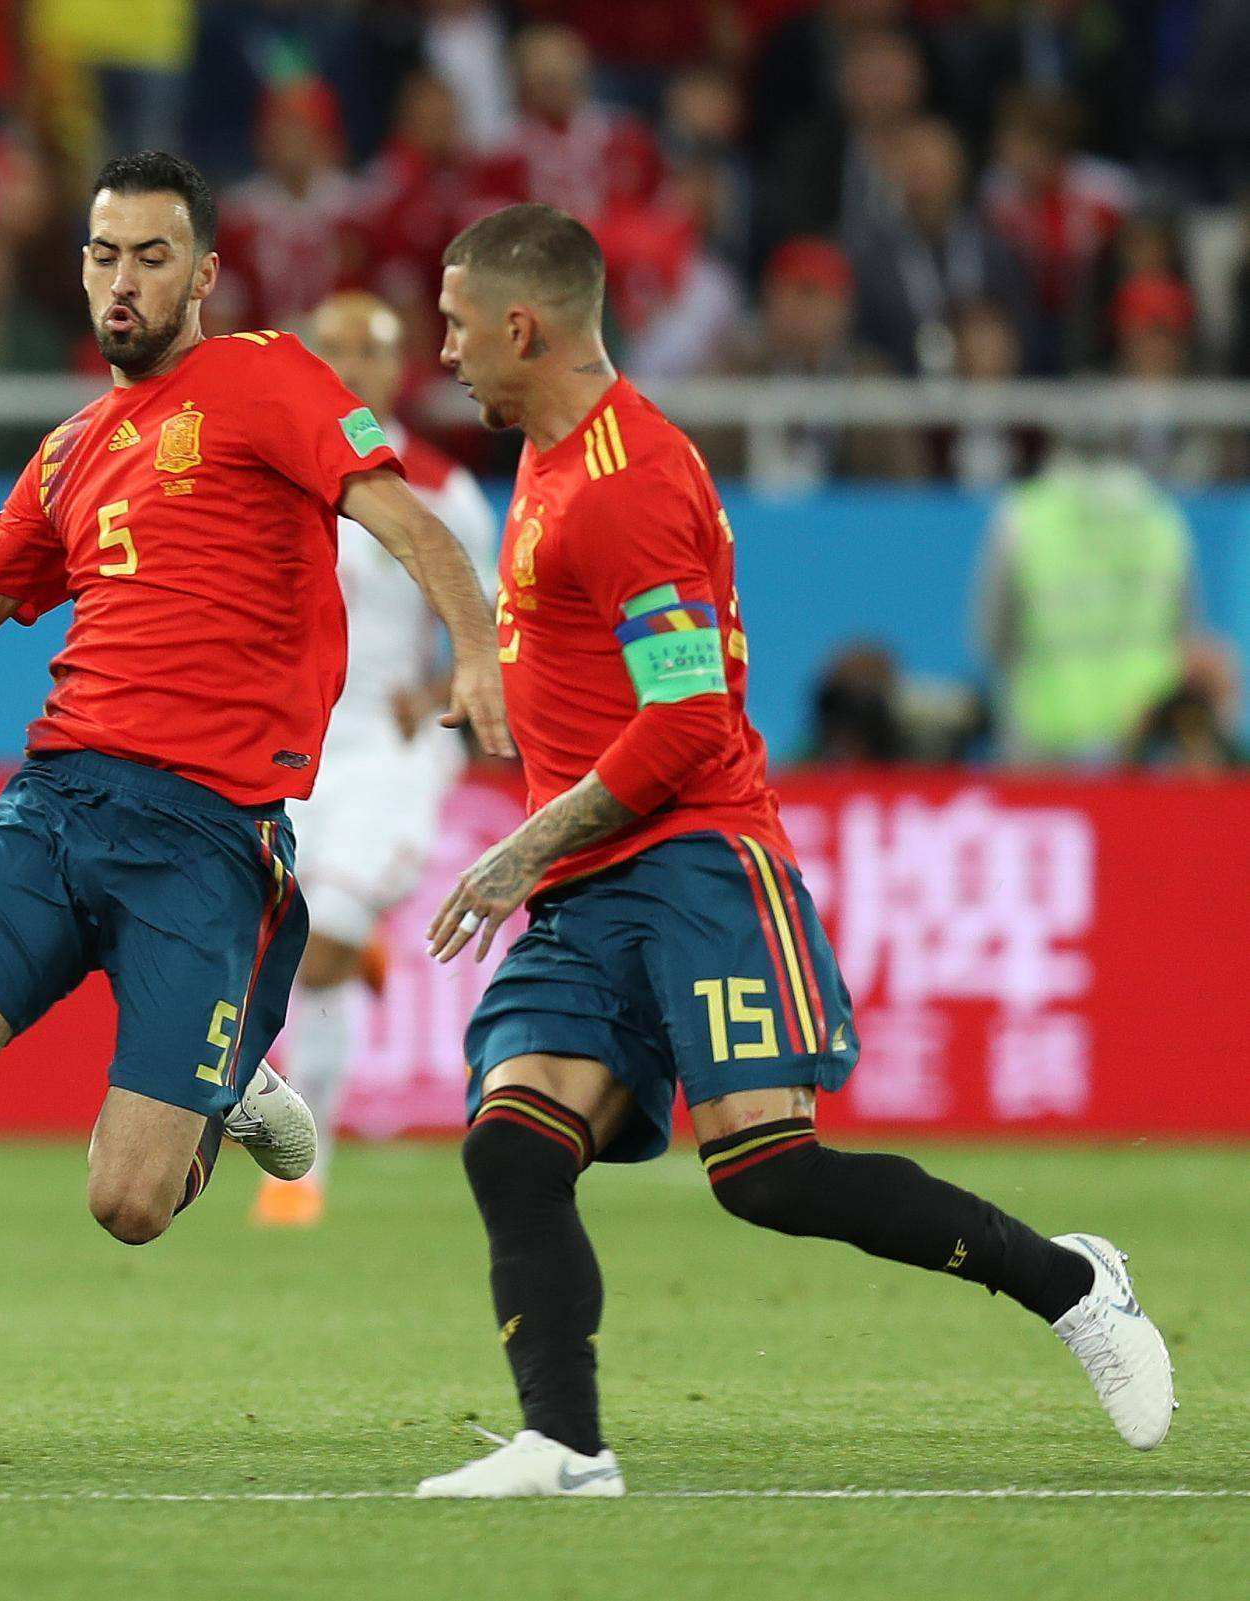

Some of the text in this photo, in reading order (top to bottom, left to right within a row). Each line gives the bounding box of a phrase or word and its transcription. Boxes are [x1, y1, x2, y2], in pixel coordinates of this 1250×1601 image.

[97, 499, 139, 576] 5
[195, 1000, 238, 1086] 5
[693, 976, 780, 1063] 15
